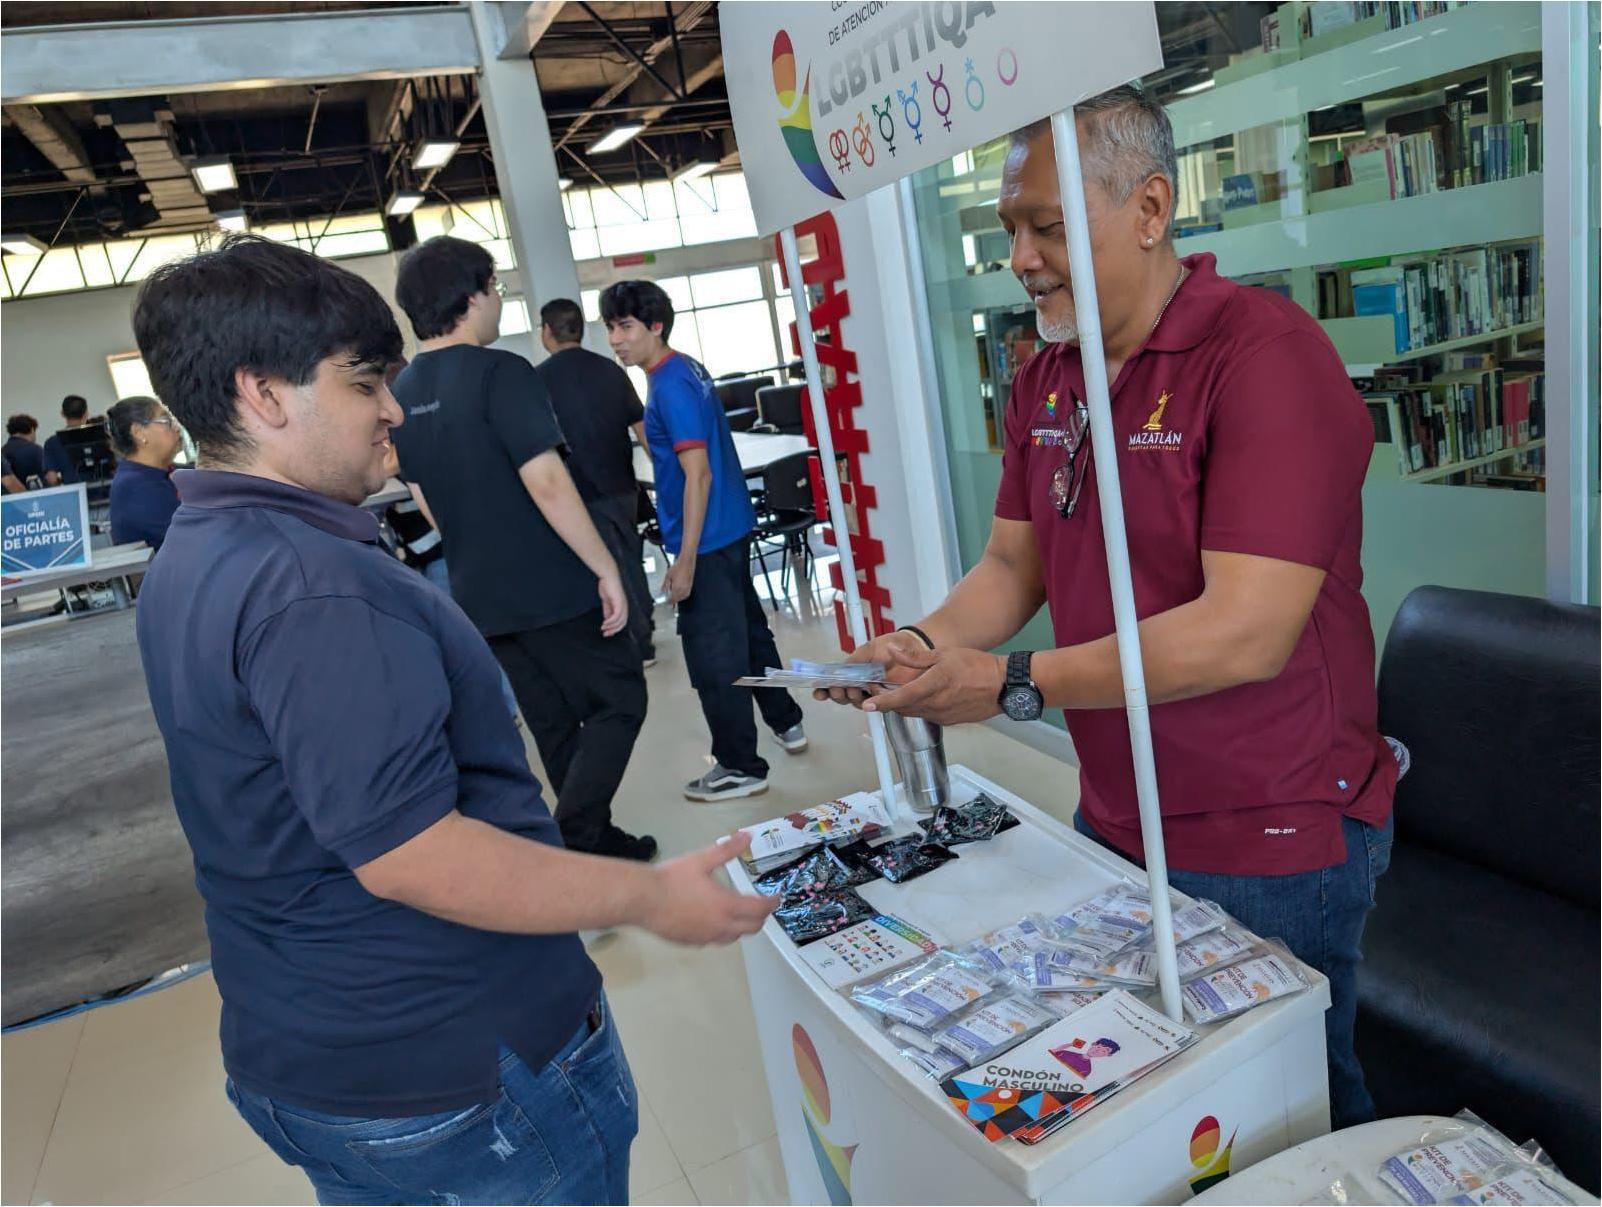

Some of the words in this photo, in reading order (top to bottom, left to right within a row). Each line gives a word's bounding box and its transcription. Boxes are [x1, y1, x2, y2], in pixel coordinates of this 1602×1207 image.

[829, 25, 840, 45] DE
[1128, 431, 1182, 445] MAZATLÁN
[5, 515, 70, 537] OFICIALÍA
[4, 539, 21, 550] DE
[25, 531, 74, 547] PARTES
[986, 1065, 1061, 1081] CONDÓN
[983, 1077, 1084, 1093] MASCULINO
[1429, 1145, 1443, 1156] KIT
[1439, 1155, 1452, 1166] DE
[1497, 1181, 1513, 1191] KIT
